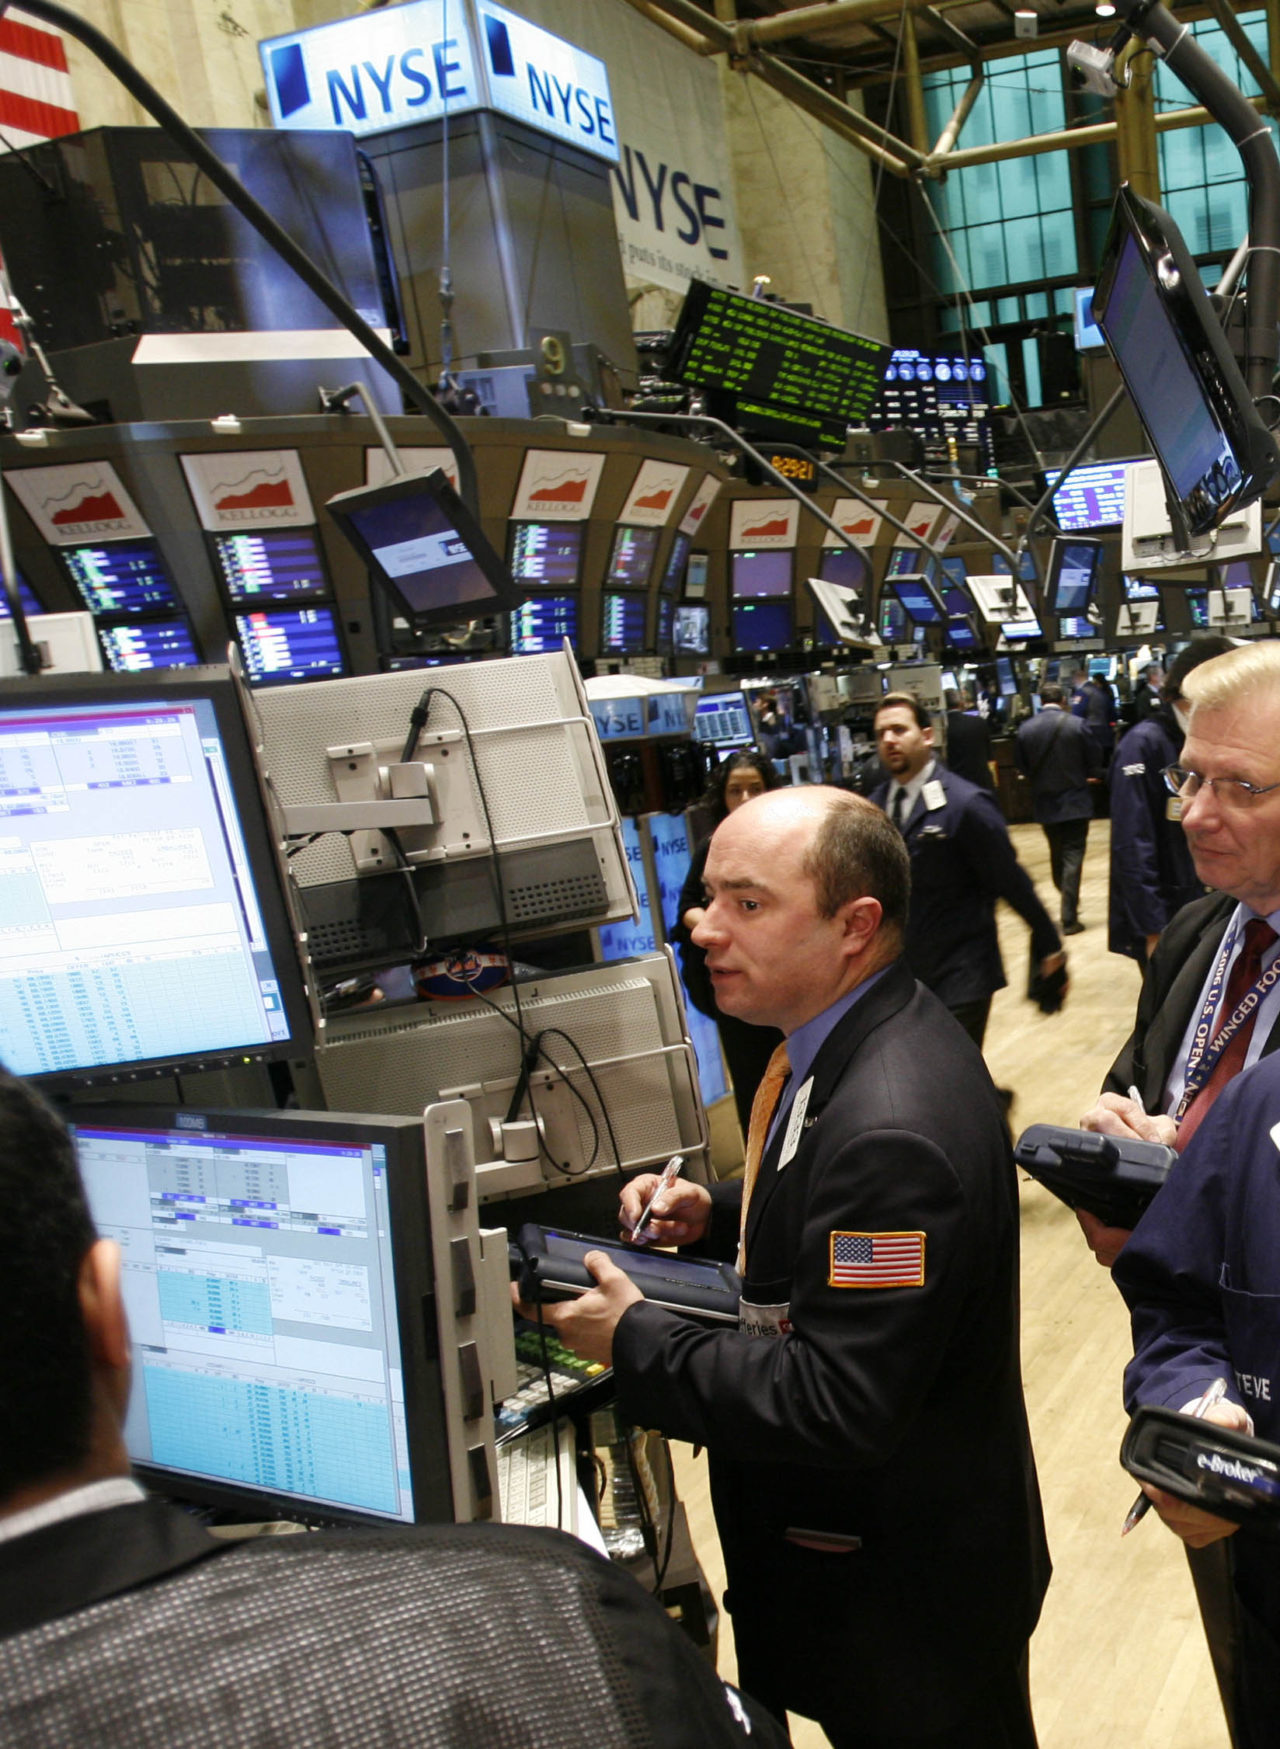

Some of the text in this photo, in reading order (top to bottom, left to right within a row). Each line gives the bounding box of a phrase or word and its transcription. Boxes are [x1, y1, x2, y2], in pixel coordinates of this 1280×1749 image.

[326, 38, 467, 126] NYSE
[526, 61, 616, 146] NYSE
[614, 144, 728, 261] NYSE
[541, 335, 566, 375] 9
[217, 506, 298, 521] KELLOGG
[594, 713, 640, 734] YSE
[661, 837, 688, 857] NYSE
[617, 936, 656, 952] NYSE
[1186, 948, 1230, 1070] 2006 U.S. OPEN
[1209, 992, 1259, 1053] WINGED
[1235, 1371, 1272, 1401] TEVE
